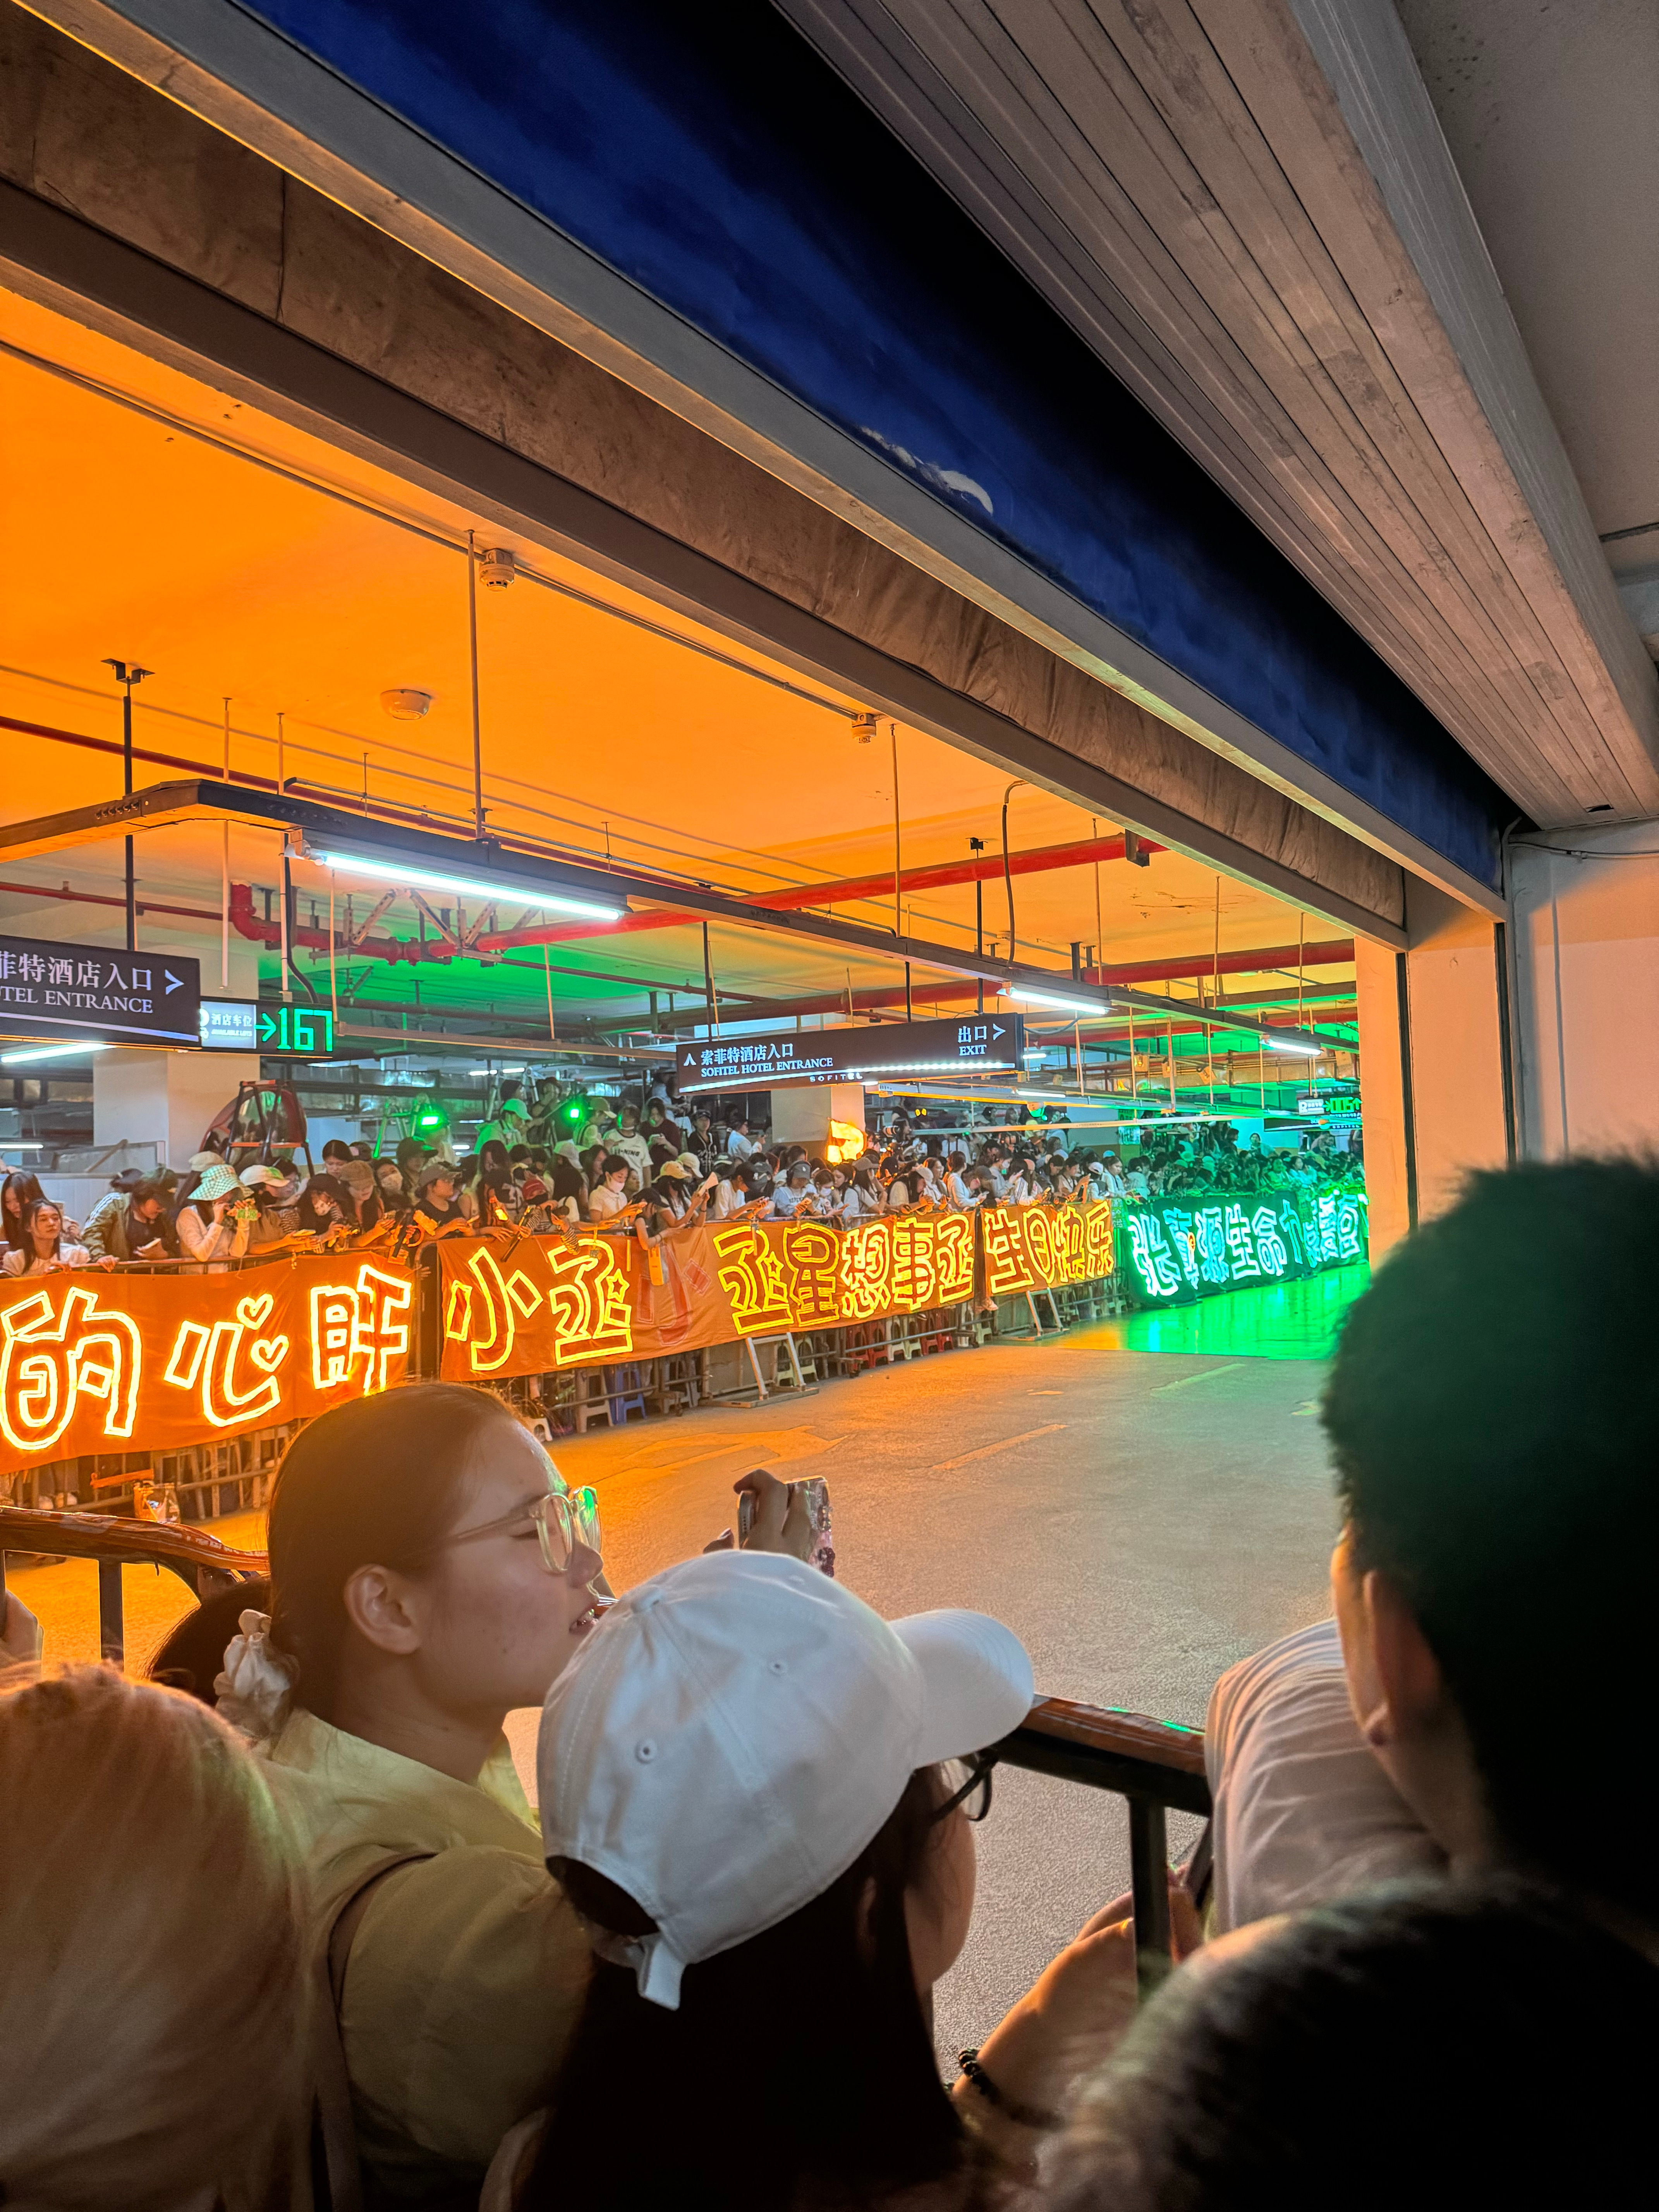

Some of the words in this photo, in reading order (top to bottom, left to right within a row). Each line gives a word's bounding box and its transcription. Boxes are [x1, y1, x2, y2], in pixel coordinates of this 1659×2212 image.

[0, 986, 38, 1004] TEL
[45, 989, 153, 1014] ENTRANCE
[211, 1013, 252, 1027] 酒店车位
[277, 1007, 333, 1051] 167
[958, 1025, 987, 1043] 出口
[701, 1043, 793, 1066] 索菲特酒店入口
[959, 1044, 987, 1056] EXIT
[701, 1065, 740, 1077] SOFITEL
[741, 1062, 775, 1074] HOTEL
[777, 1057, 833, 1071] ENTRANCE
[809, 1072, 863, 1082] SOFITEL
